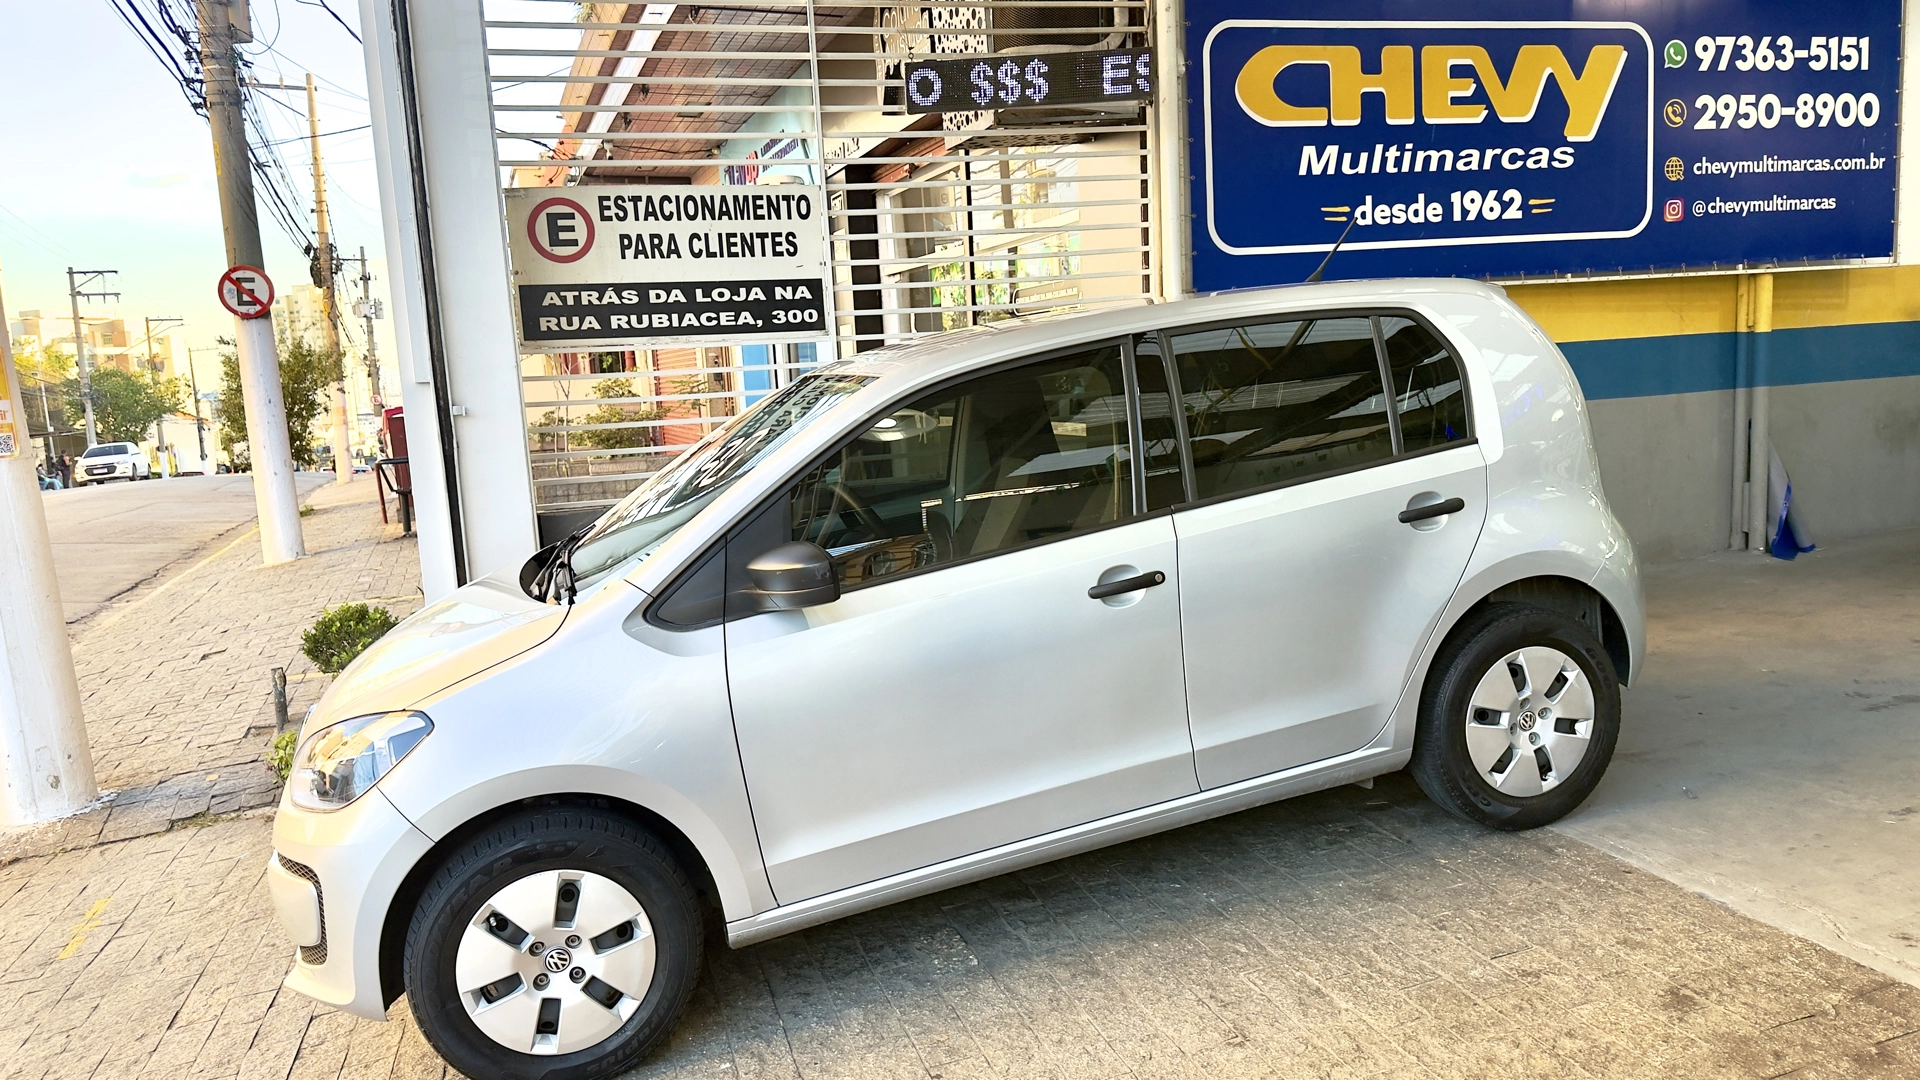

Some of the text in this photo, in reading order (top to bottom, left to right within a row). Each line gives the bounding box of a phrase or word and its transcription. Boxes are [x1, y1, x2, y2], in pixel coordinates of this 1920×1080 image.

[1694, 35, 1870, 71] 97363-5151
[908, 68, 942, 105] O
[1235, 45, 1629, 141] CHEVY
[1694, 93, 1880, 129] 2950-8900
[1298, 144, 1575, 176] Multimarcas
[1692, 152, 1886, 179] chevymultimarcas.com.br
[597, 194, 811, 222] ESTACIONAMENTO
[1354, 189, 1523, 226] desde 1962
[1692, 195, 1836, 216] @chevymultimarcas
[546, 212, 579, 247] E
[618, 231, 798, 260] PARA CLIENTES
[541, 285, 813, 306] ATRÁS DA LOJA NA
[539, 308, 819, 332] RUA RUBIACEA, 300
